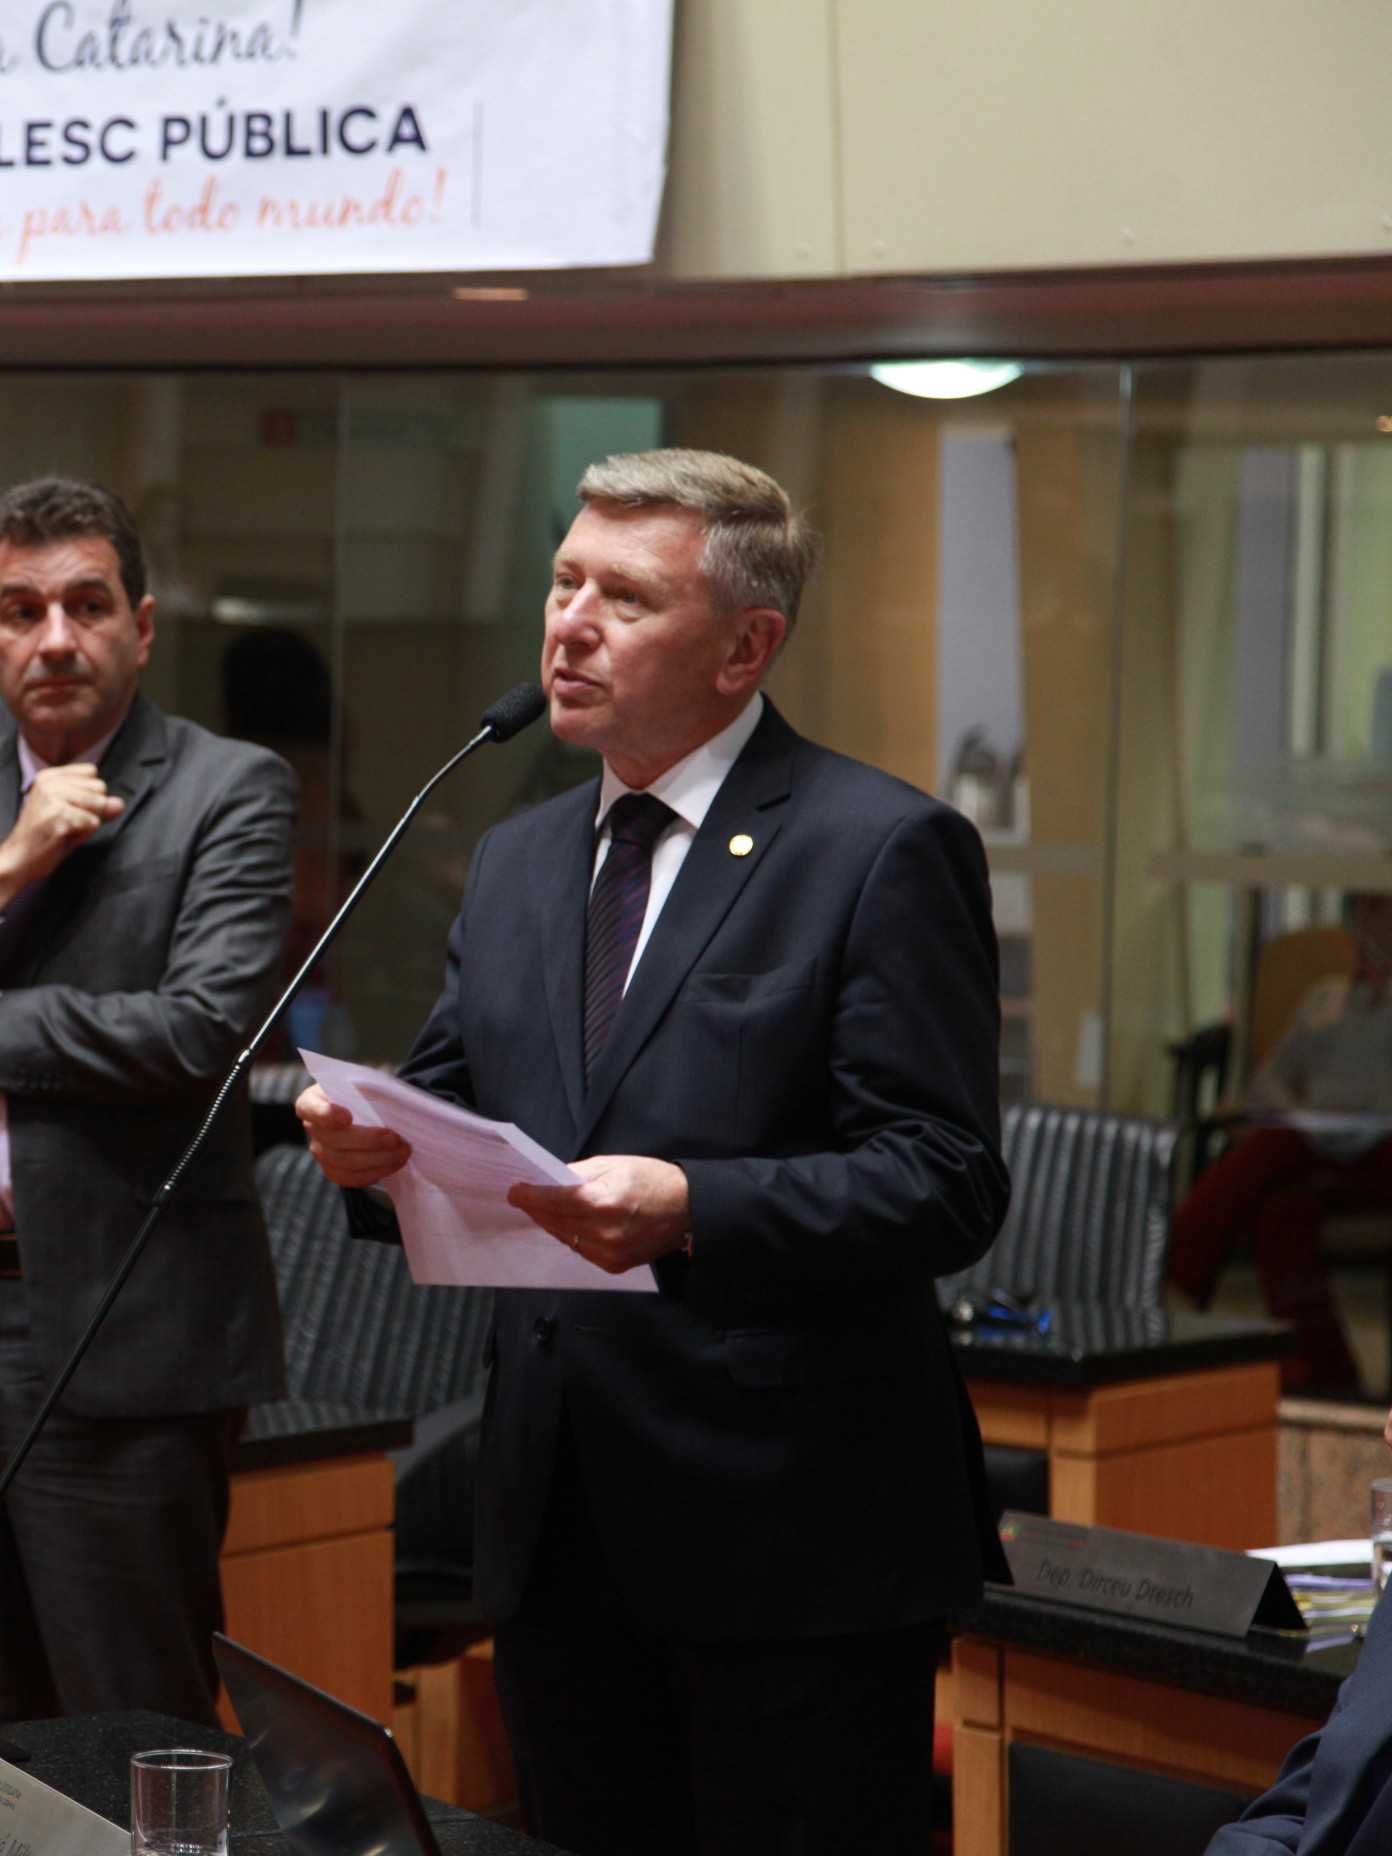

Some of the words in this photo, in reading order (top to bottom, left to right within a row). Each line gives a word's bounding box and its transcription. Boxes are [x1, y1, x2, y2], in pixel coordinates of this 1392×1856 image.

[35, 0, 305, 73] Catarina!
[161, 99, 429, 163] PÚBLICA
[16, 195, 133, 267] para
[143, 175, 240, 234] todo
[256, 166, 448, 232] mundo!
